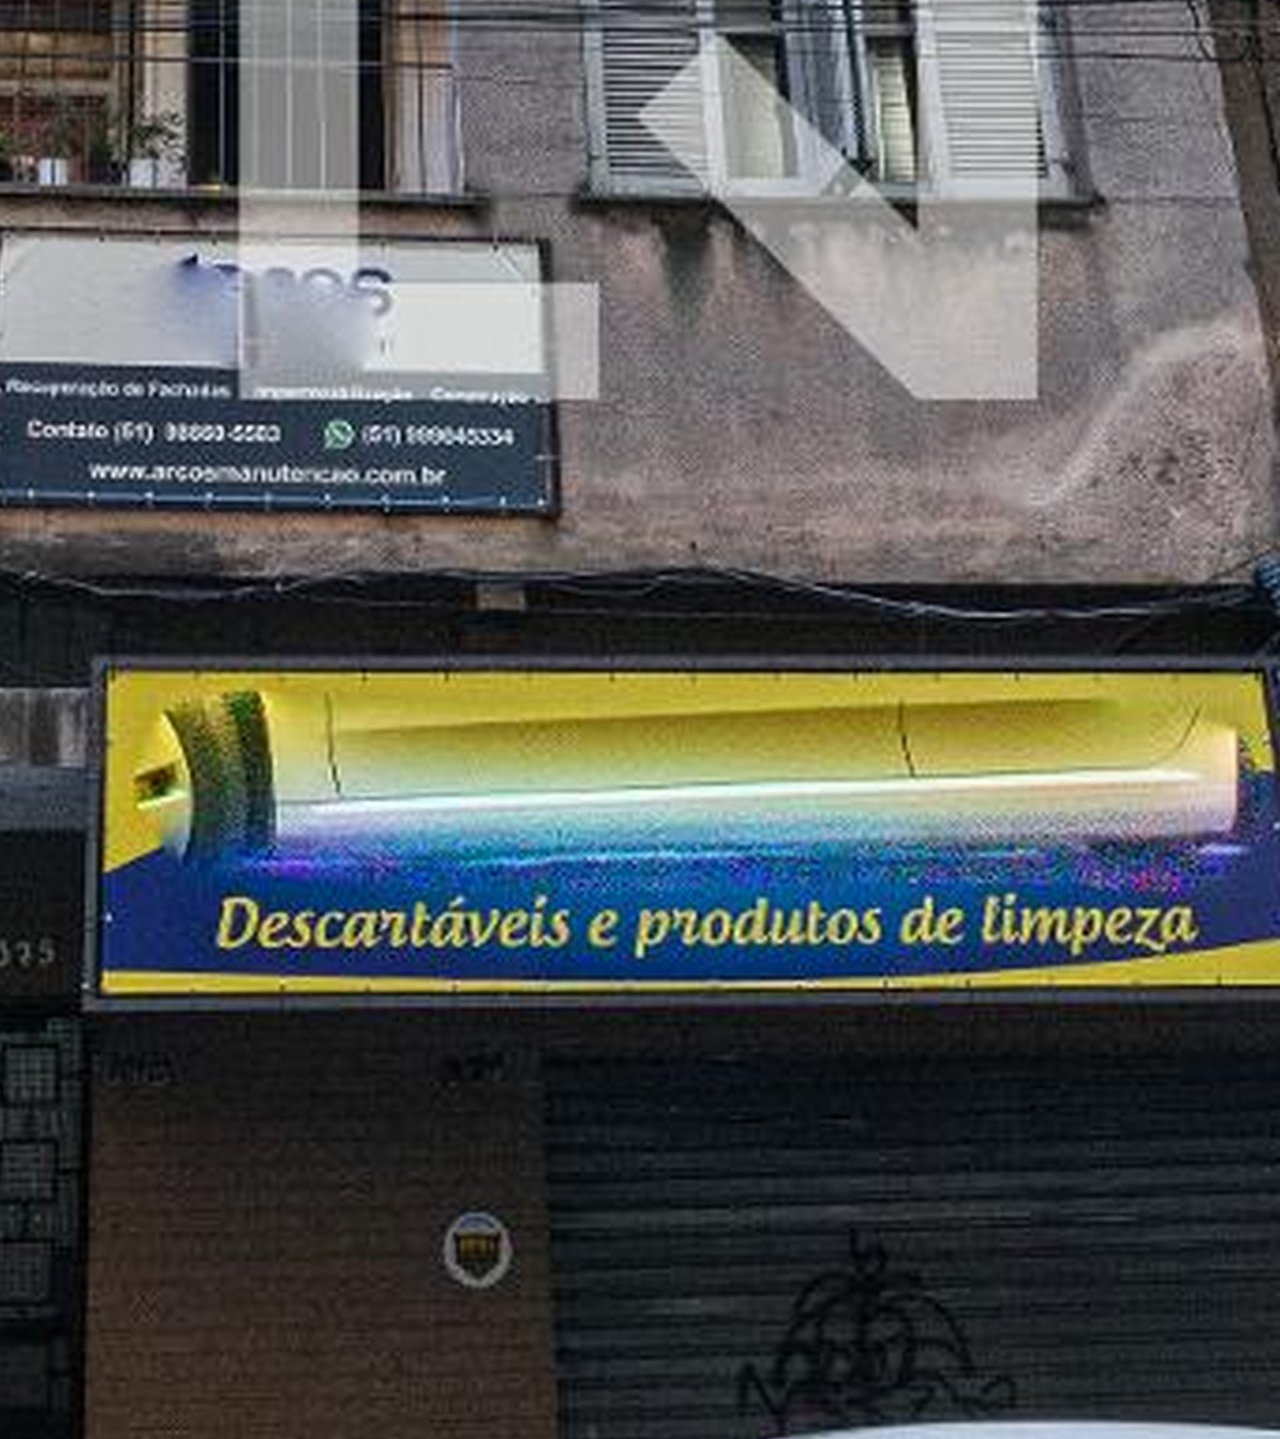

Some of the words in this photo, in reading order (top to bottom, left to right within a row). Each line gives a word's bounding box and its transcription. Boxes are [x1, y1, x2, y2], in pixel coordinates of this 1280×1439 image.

[123, 382, 144, 398] de
[27, 420, 110, 440] Contato
[217, 896, 570, 950] Descartáveis
[588, 918, 617, 948] e
[634, 896, 882, 958] produtos
[900, 896, 964, 946] de
[981, 893, 1199, 955] limpeza
